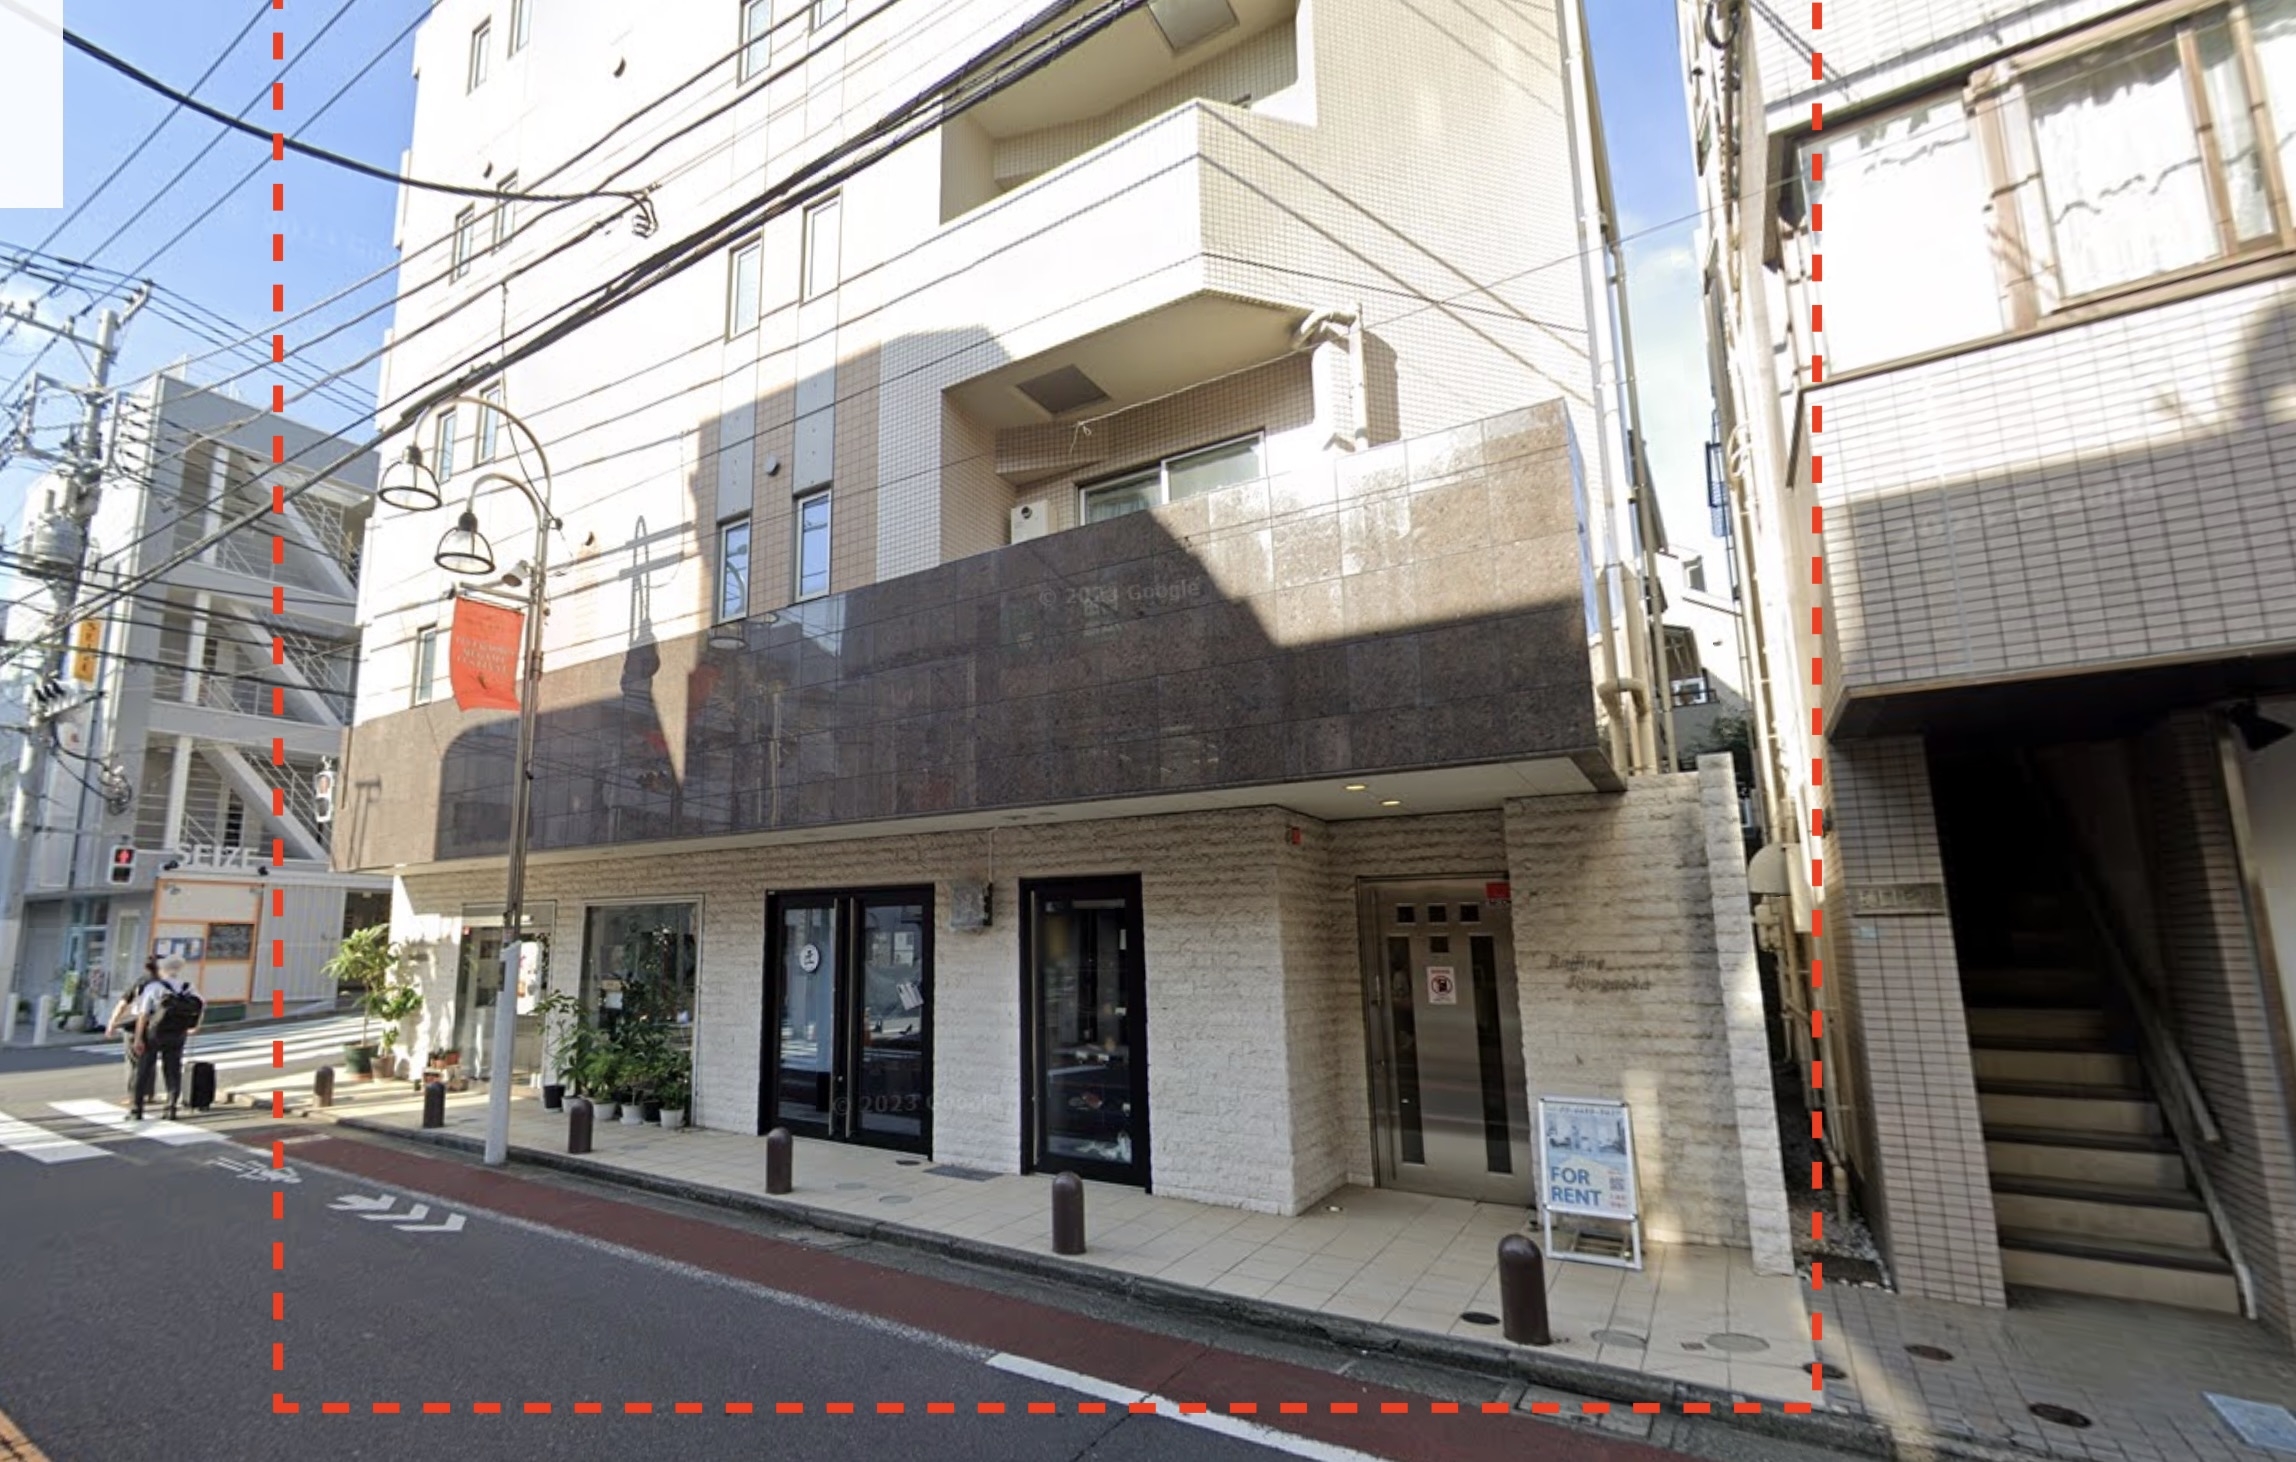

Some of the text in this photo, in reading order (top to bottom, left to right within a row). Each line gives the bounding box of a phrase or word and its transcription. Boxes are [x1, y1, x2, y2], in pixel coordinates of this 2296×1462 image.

[175, 842, 260, 867] SEIZE
[1550, 1166, 1591, 1185] FOR
[1551, 1186, 1602, 1206] RENT
